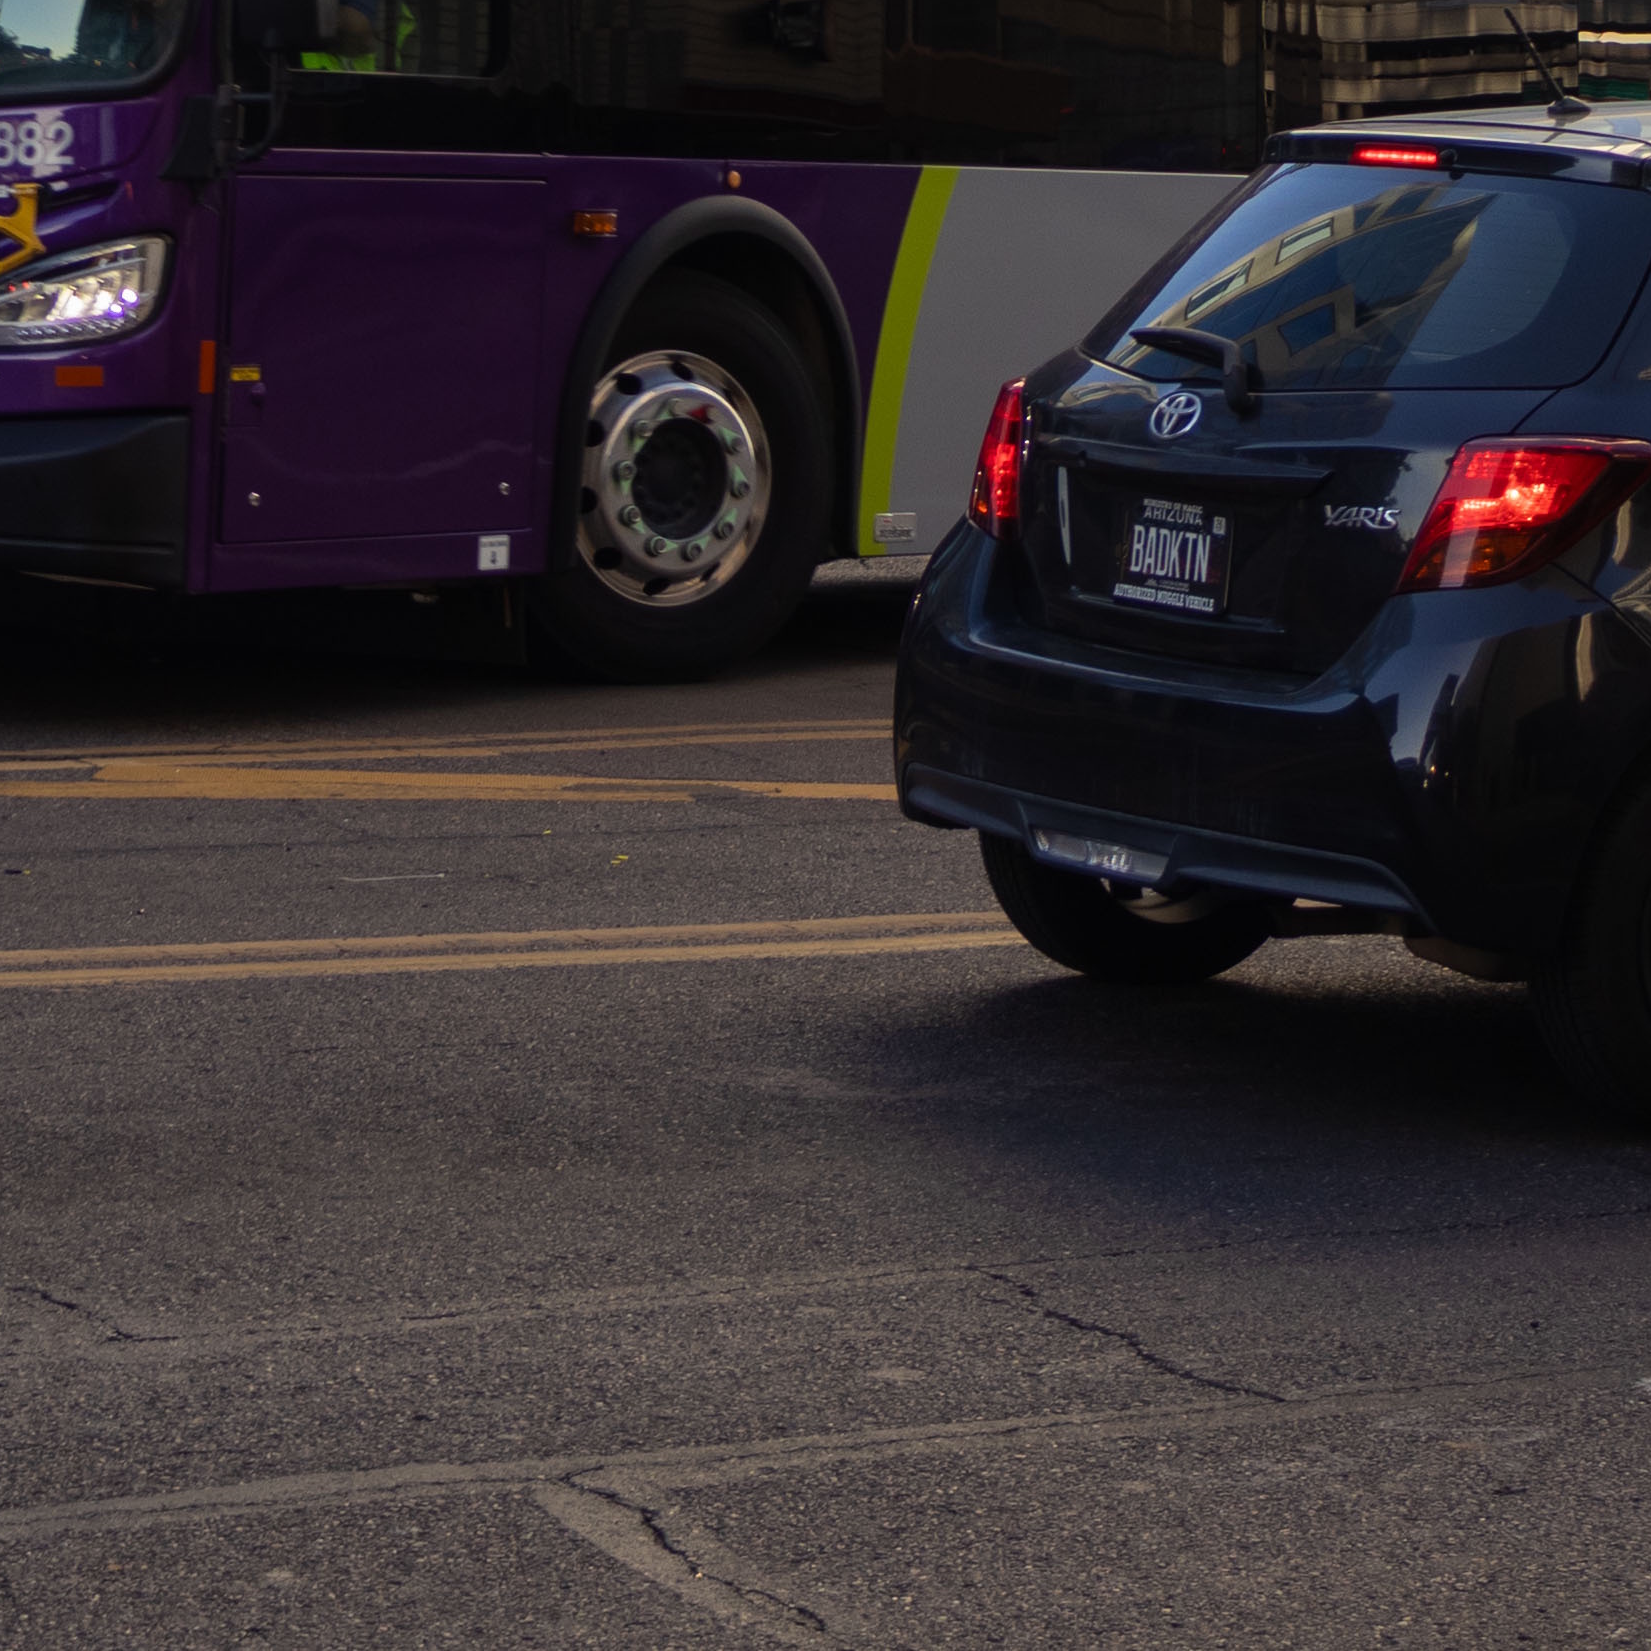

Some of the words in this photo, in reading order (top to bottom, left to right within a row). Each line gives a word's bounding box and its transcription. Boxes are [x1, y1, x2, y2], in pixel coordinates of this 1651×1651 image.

[1143, 506, 1203, 526] ARIZONA
[1324, 504, 1401, 530] YARIS
[1130, 524, 1211, 583] BADKTN
